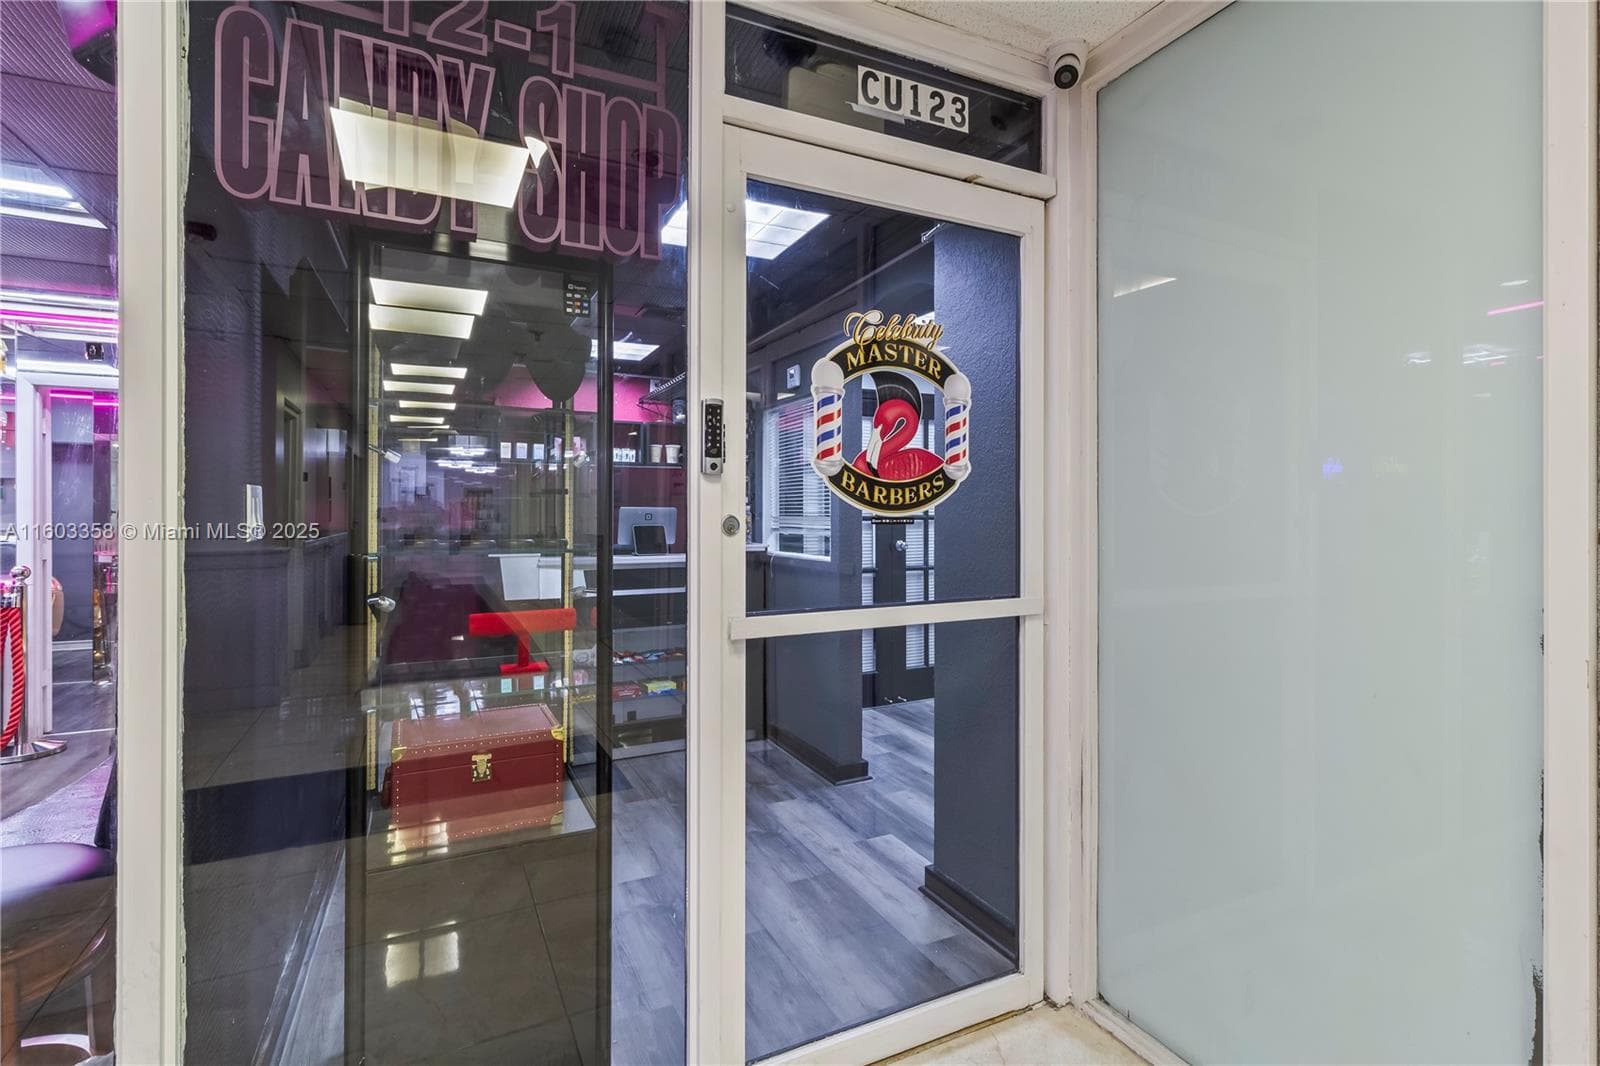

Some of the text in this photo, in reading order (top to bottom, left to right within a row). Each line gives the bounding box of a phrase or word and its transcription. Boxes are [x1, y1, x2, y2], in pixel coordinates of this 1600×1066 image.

[861, 70, 967, 128] CU123
[214, 5, 682, 260] CANDY SHOP
[843, 309, 944, 352] Celebrity
[846, 343, 942, 380] MASTER
[840, 470, 945, 506] BARBERS
